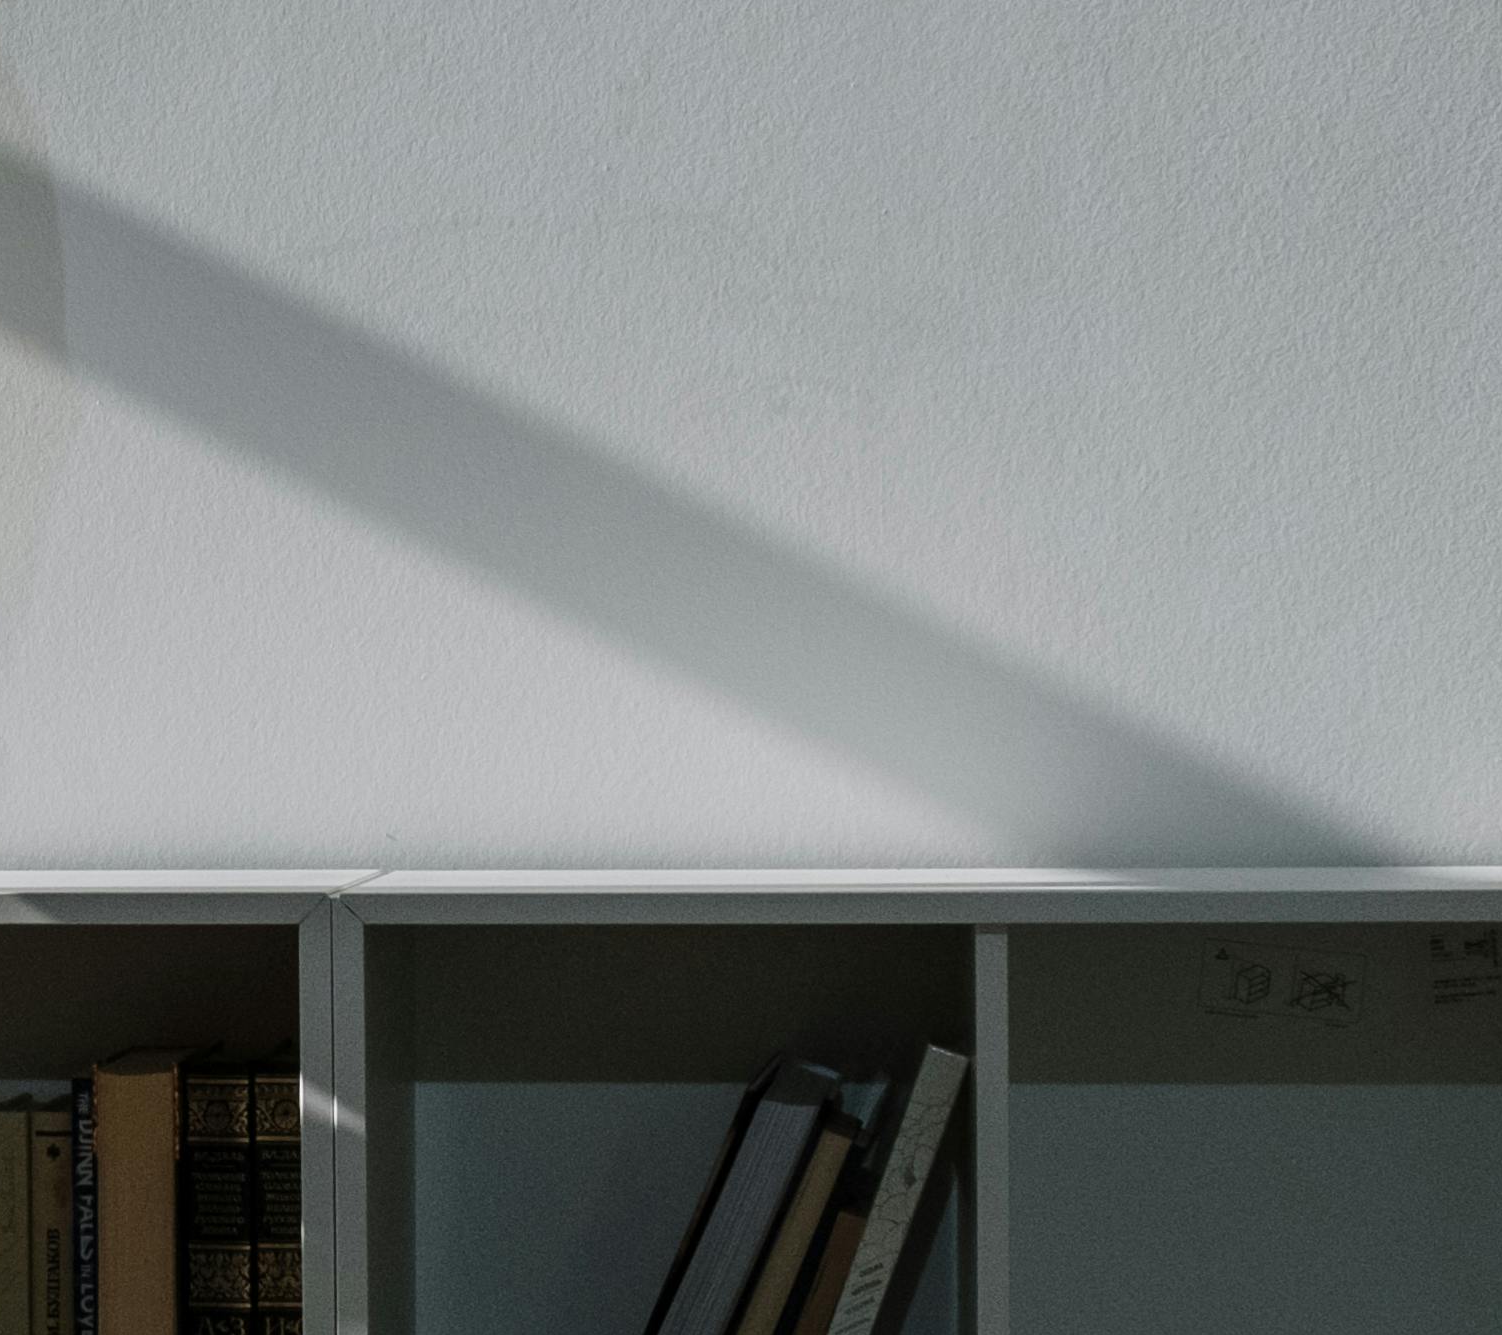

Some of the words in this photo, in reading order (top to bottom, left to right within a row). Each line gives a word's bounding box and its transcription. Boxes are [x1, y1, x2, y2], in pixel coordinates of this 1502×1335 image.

[77, 1119, 93, 1185] DJINN
[79, 1194, 95, 1262] FALLS
[47, 1228, 61, 1314] БУЛГАКОВ
